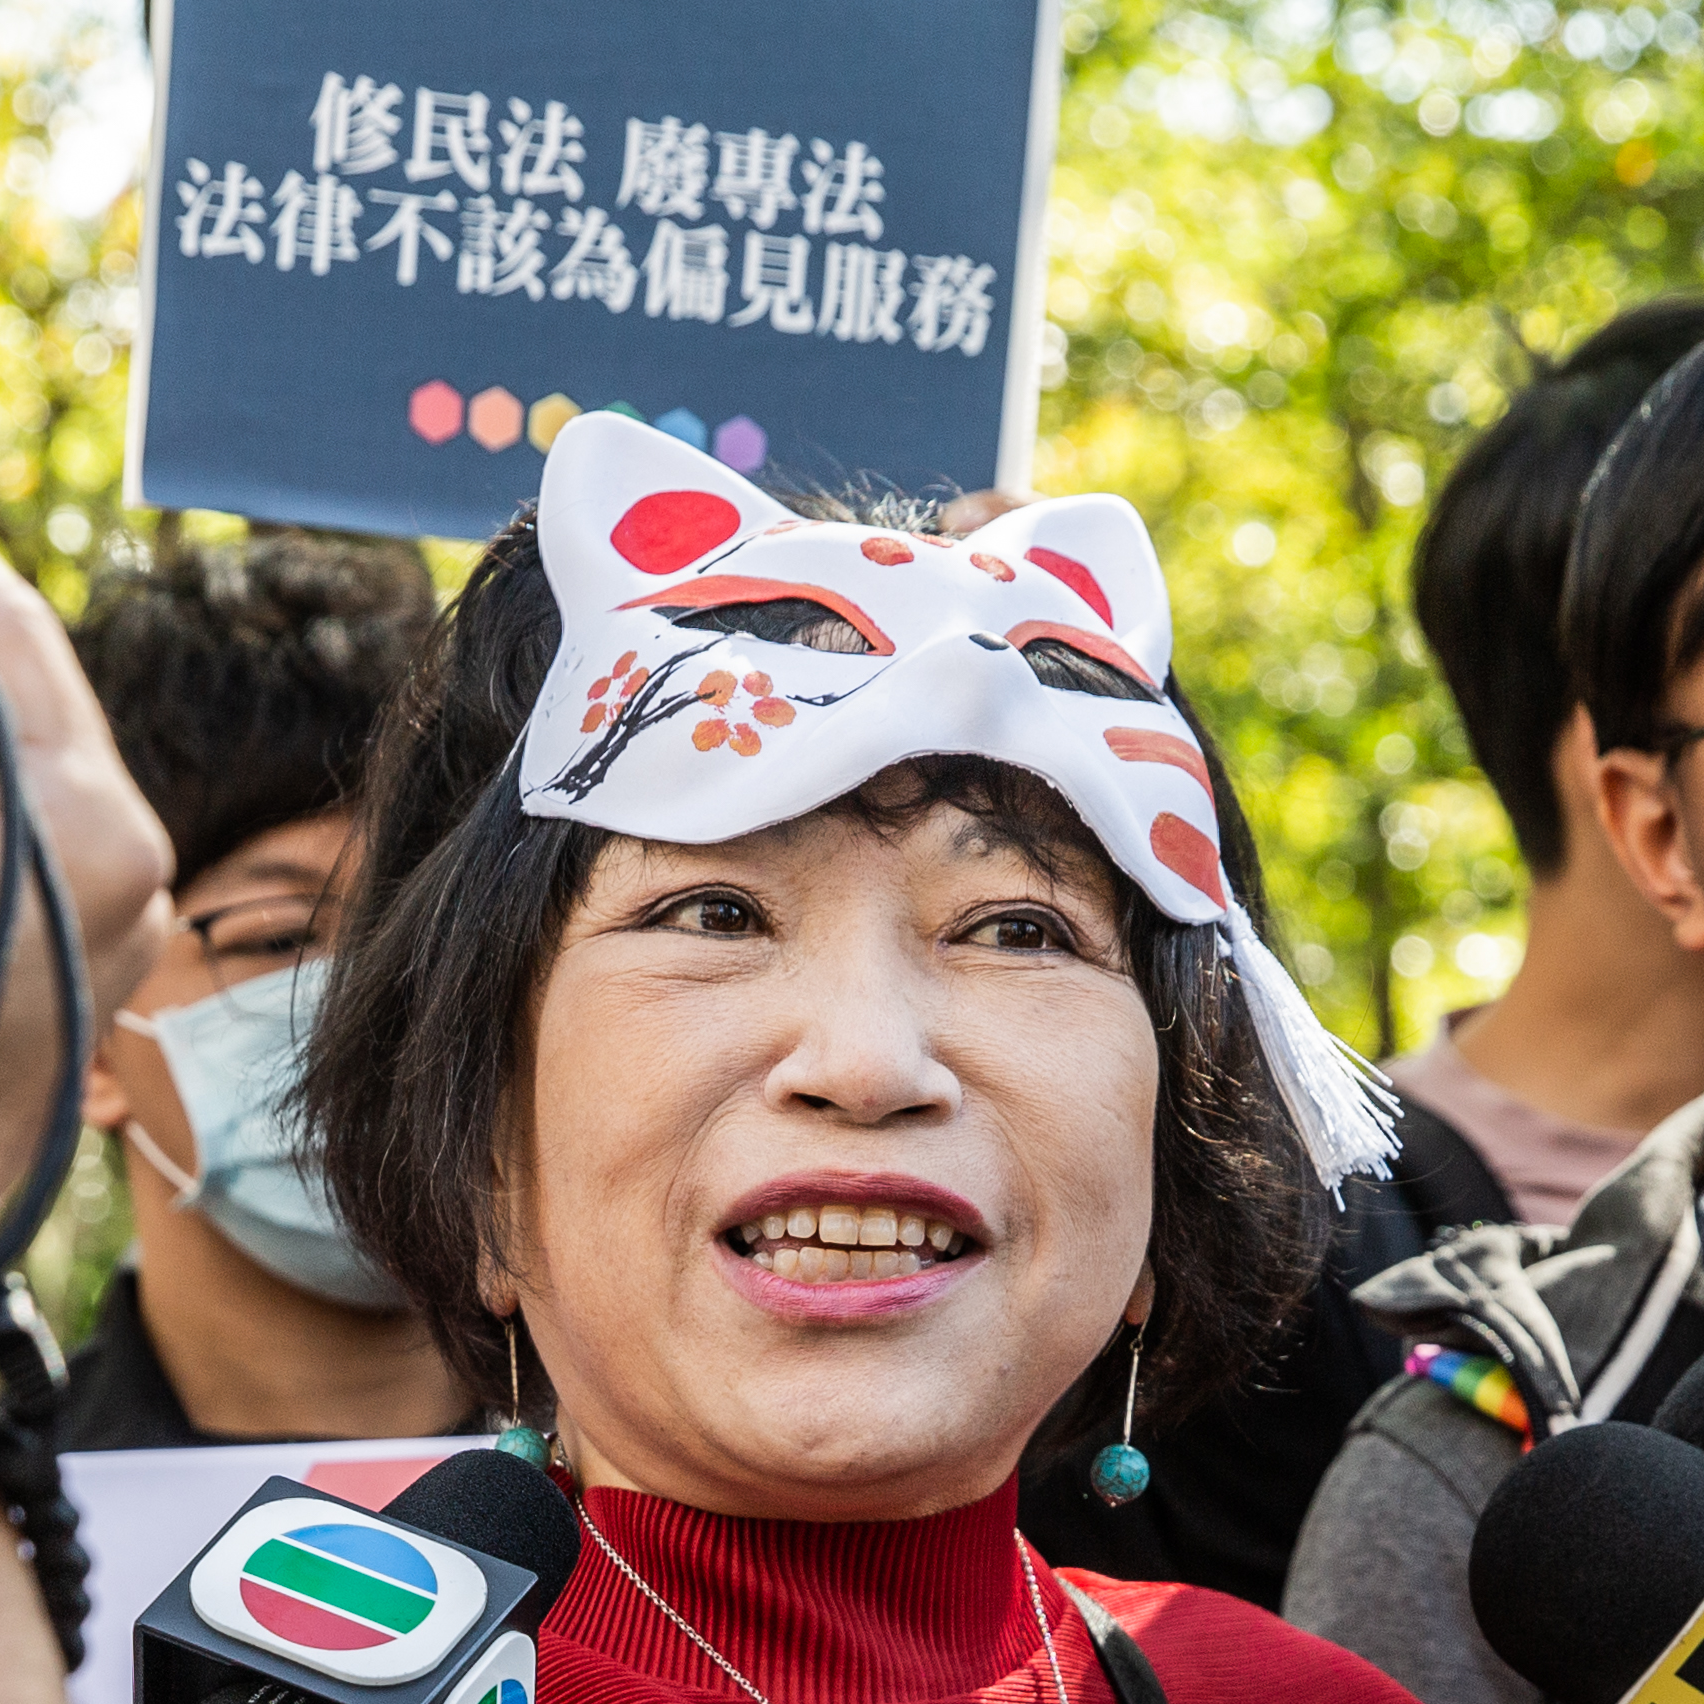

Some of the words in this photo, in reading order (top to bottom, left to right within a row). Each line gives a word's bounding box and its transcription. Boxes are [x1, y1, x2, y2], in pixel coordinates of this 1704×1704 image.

[309, 70, 586, 203] 修民法
[616, 114, 887, 242] 廢專法
[175, 158, 998, 357] 法律不該為偏見服務
